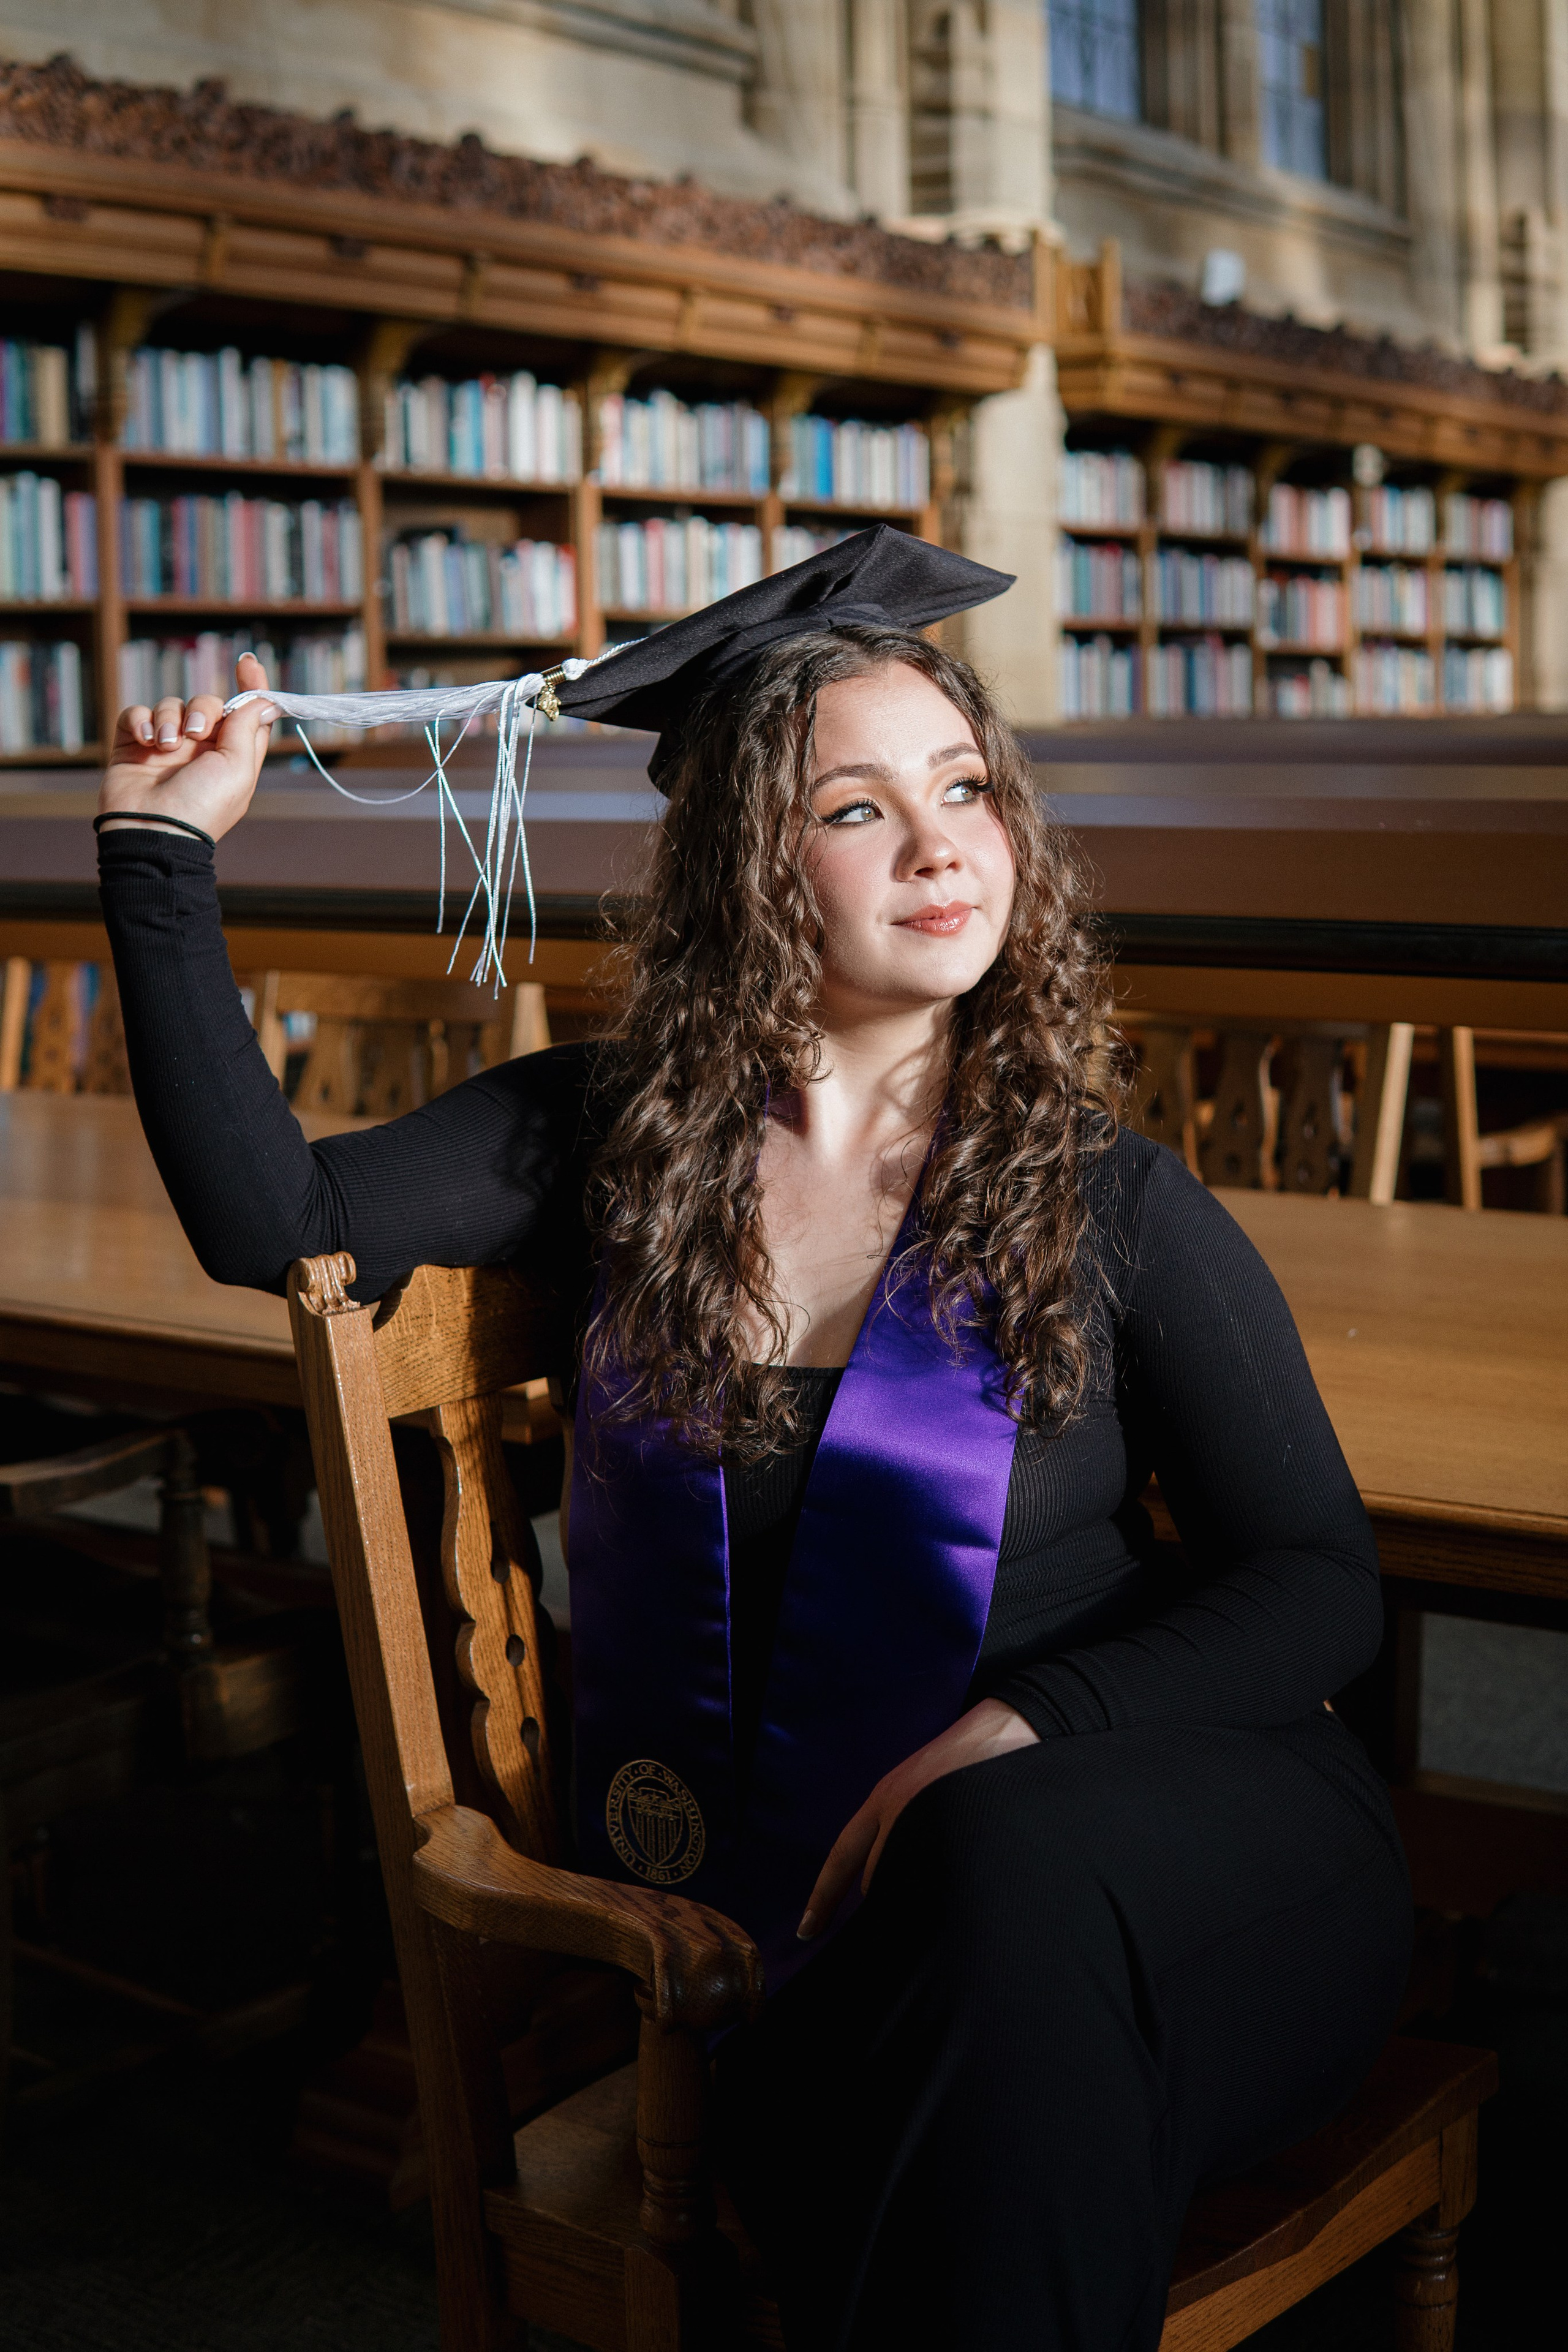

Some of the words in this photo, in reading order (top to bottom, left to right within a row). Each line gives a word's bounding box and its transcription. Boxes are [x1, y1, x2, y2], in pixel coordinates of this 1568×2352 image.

[609, 1769, 635, 1866] UNIVERSITY
[638, 1763, 657, 1775] OF
[662, 1770, 702, 1874] WASHINGTON
[646, 1867, 671, 1881] 1861
